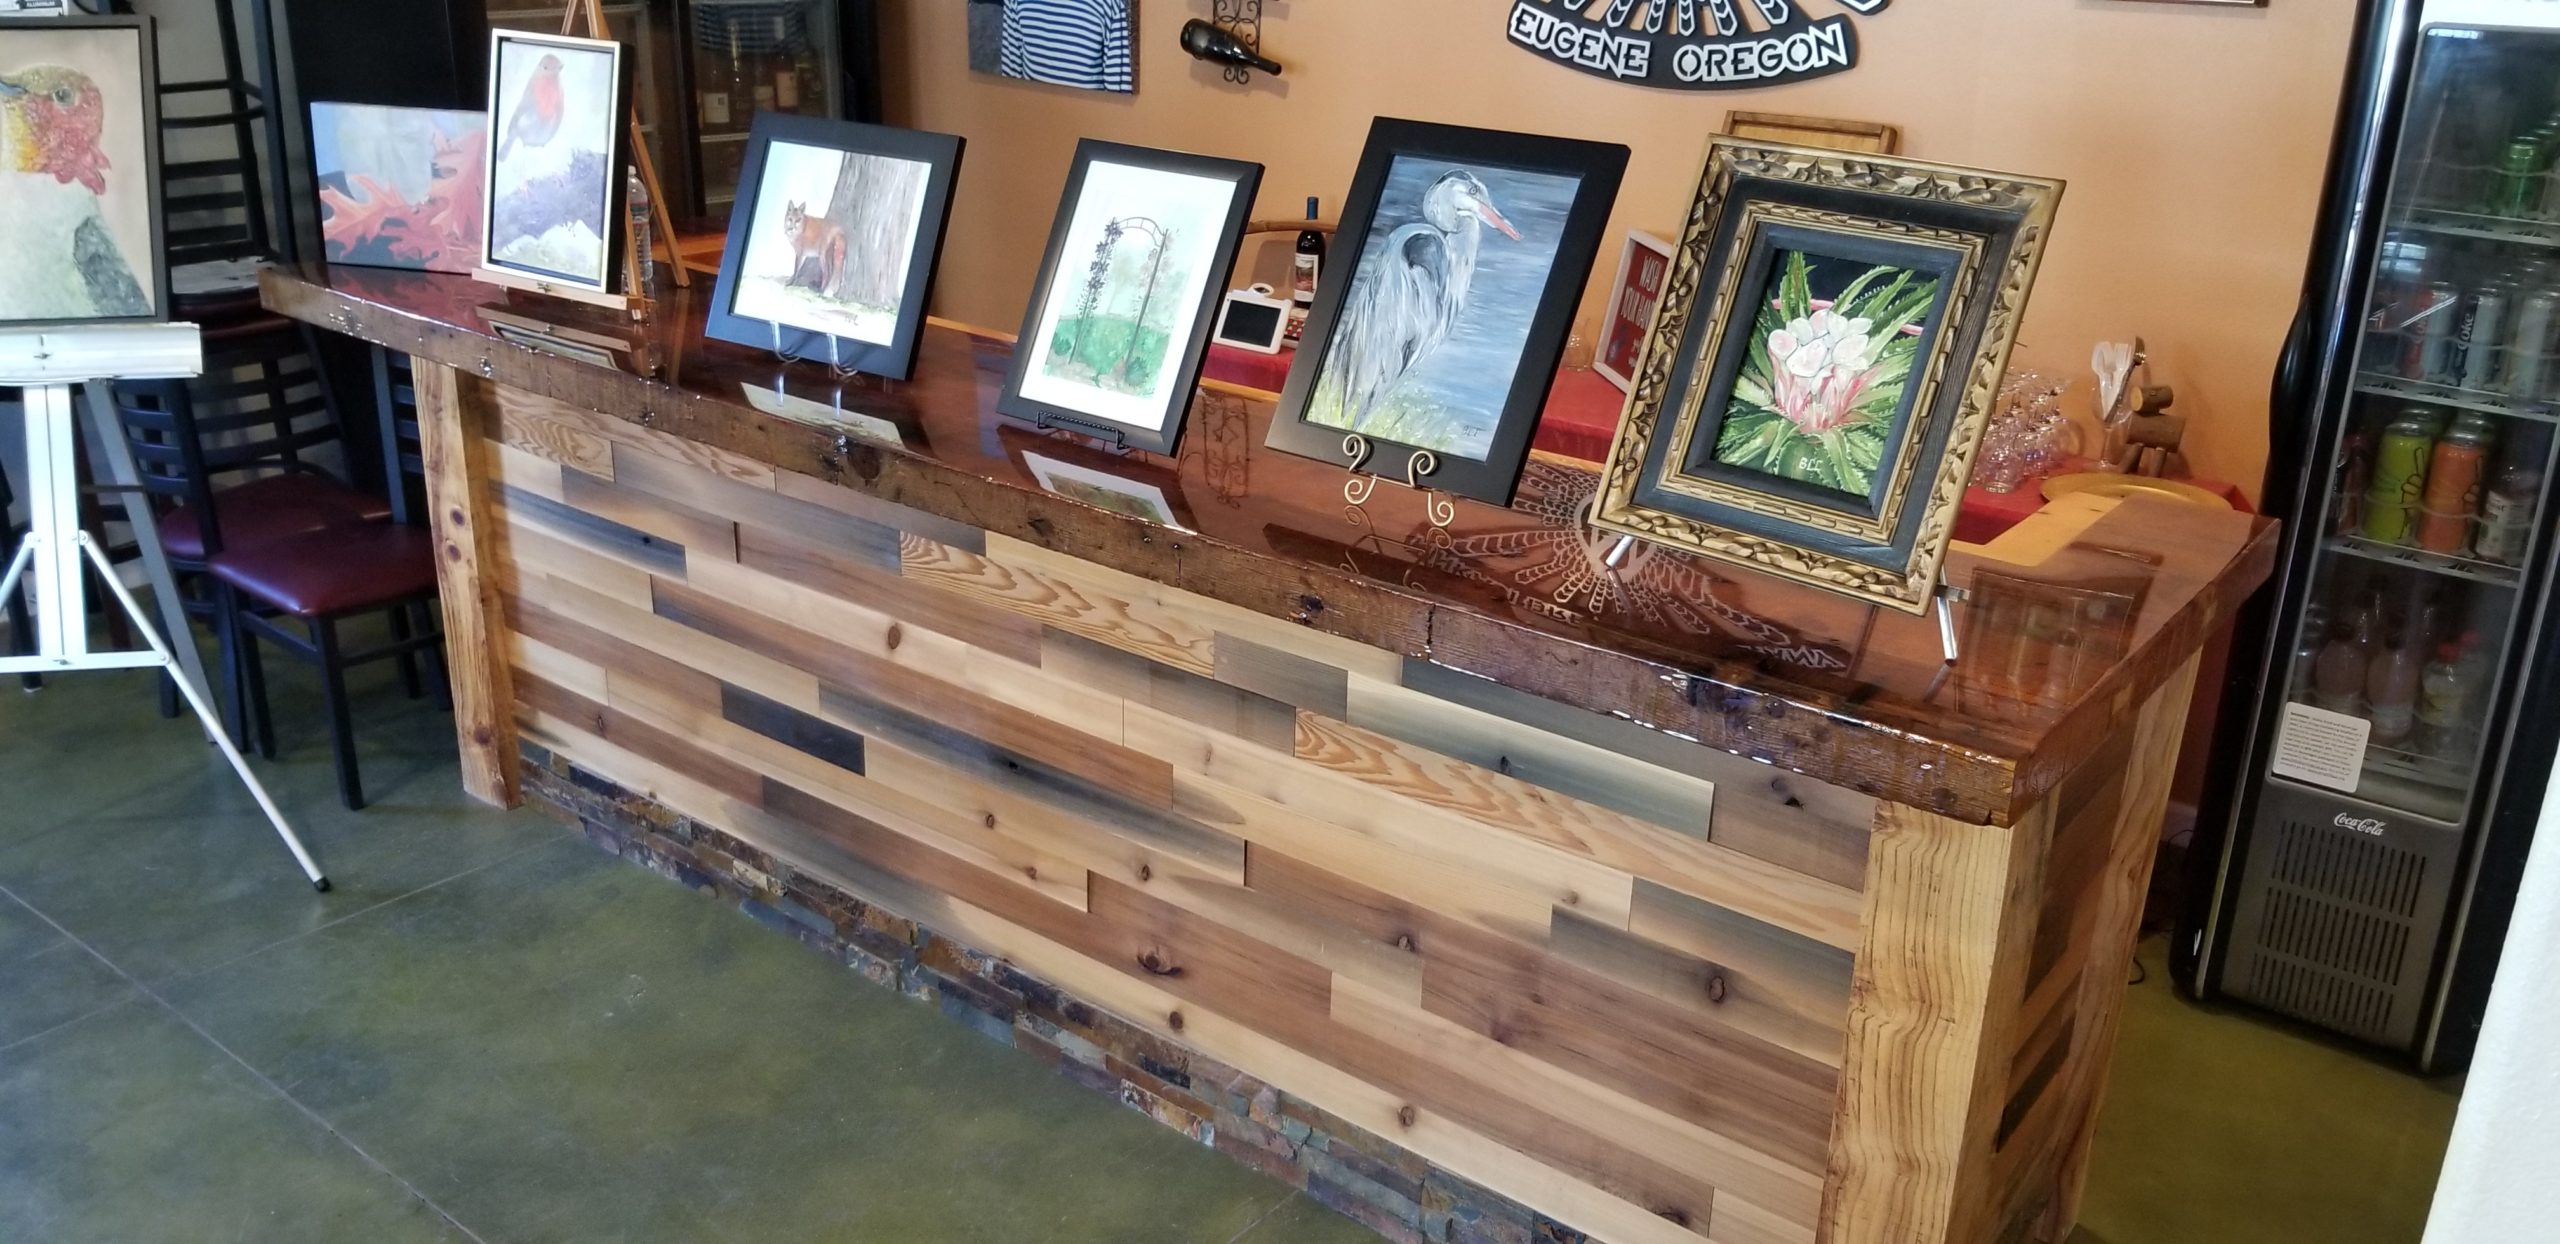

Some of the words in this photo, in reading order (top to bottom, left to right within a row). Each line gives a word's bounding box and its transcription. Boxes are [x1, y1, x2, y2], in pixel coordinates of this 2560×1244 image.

[1509, 3, 1651, 78] EUGENE
[1673, 22, 1848, 81] OREGON
[1639, 255, 1662, 294] WASH
[2333, 811, 2387, 837] Coca-Cola
